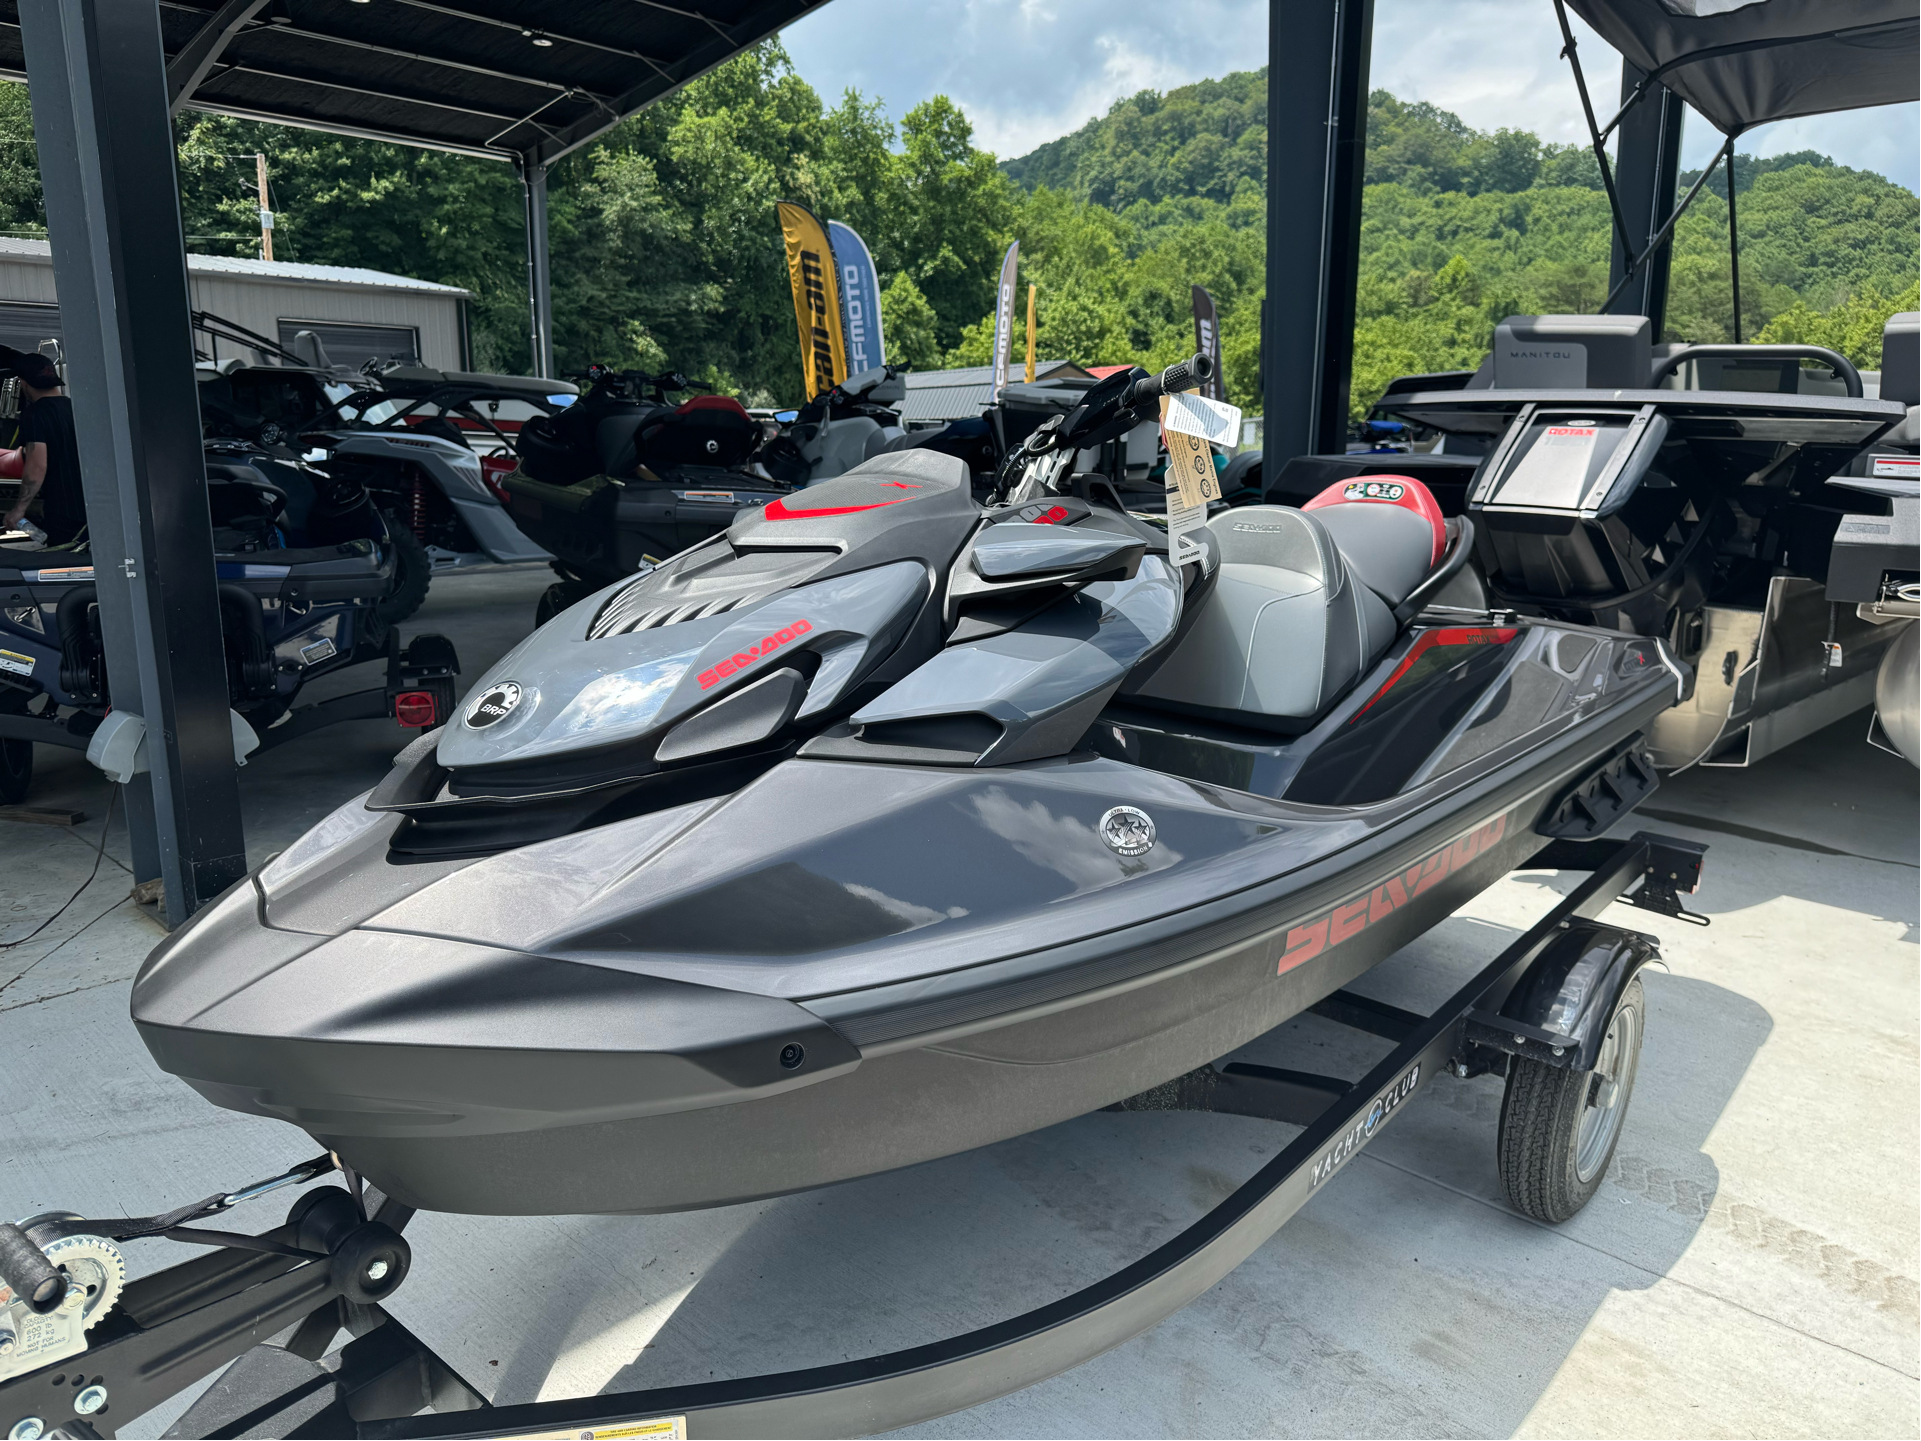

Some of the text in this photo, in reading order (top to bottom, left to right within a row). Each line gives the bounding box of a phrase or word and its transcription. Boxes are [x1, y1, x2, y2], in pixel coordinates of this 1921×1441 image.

[1548, 427, 1596, 436] ROTAX
[480, 703, 507, 716] BRP
[1118, 845, 1148, 856] EMISSION
[1313, 1066, 1419, 1186] YACHT CLUB
[26, 1326, 42, 1336] 600
[26, 1332, 42, 1342] 272
[27, 1340, 40, 1349] NOT
[41, 1337, 66, 1349] HUMANS
